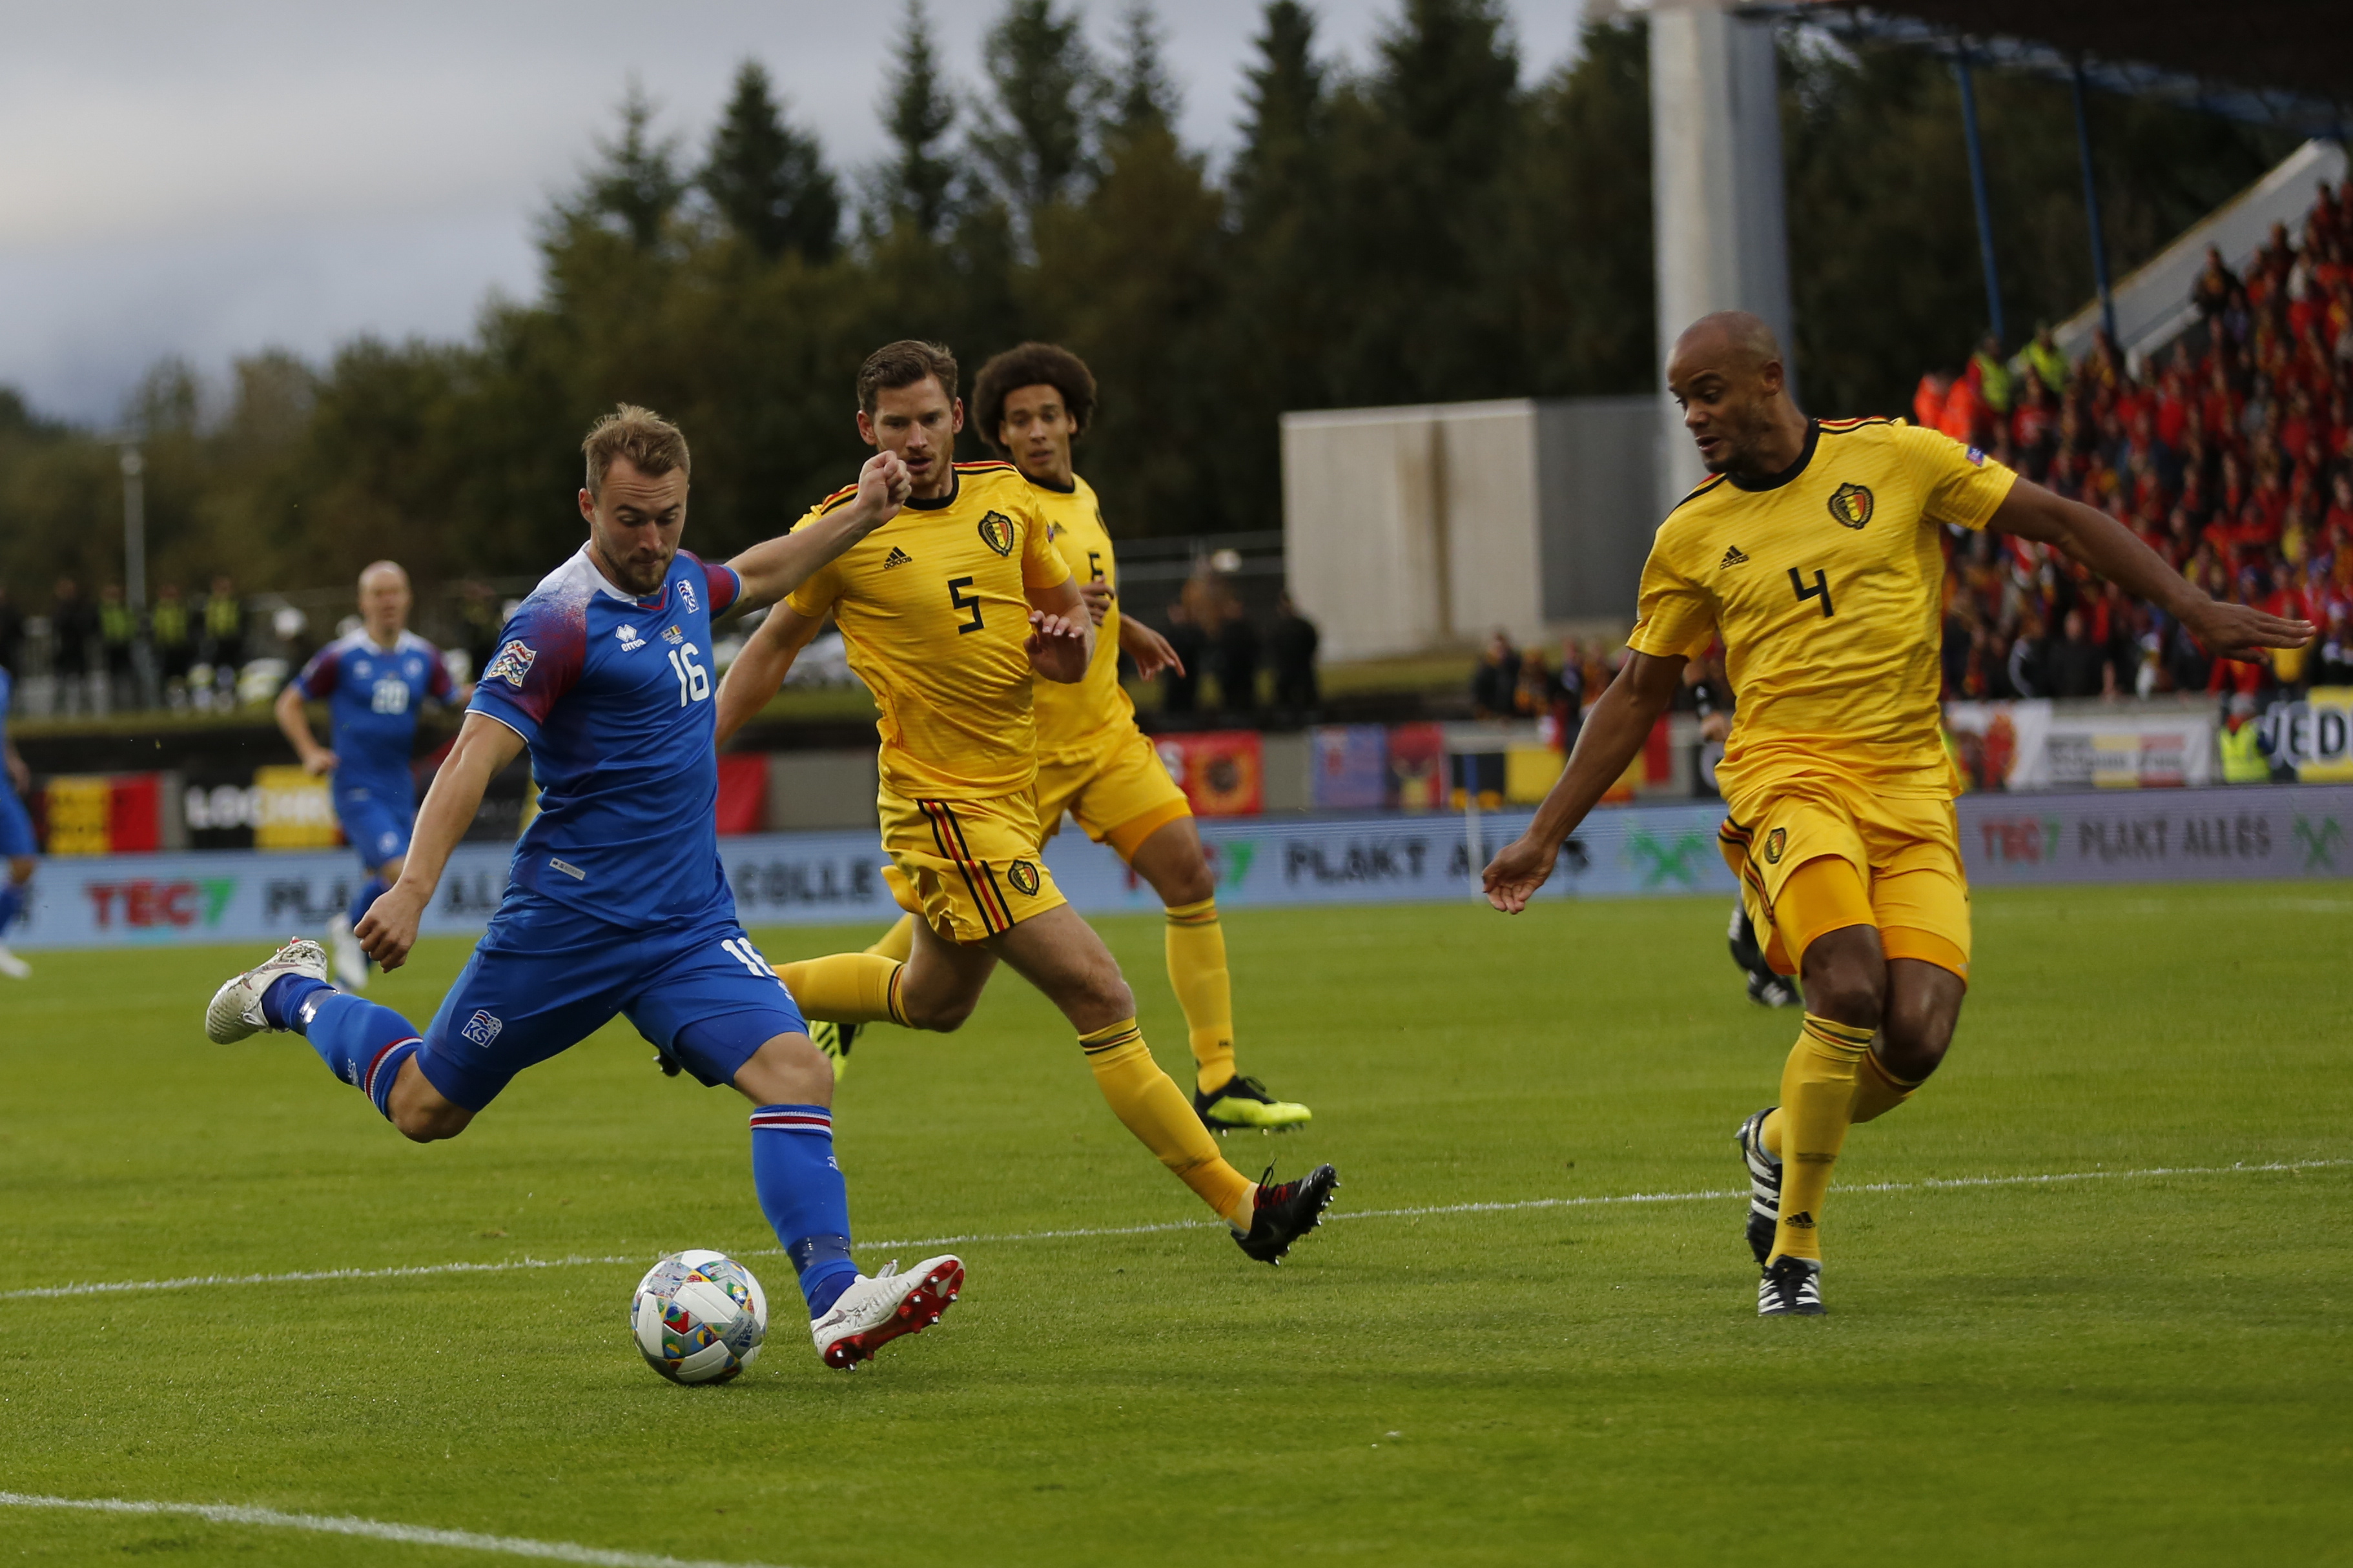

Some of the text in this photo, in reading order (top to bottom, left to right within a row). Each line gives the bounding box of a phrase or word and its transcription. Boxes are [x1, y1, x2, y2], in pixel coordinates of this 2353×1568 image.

[883, 556, 912, 569] adidas
[1720, 555, 1749, 570] adidas
[947, 576, 984, 634] 5
[1788, 567, 1834, 617] 4
[668, 642, 710, 708] 16
[1284, 839, 1428, 884] PLAKT
[85, 879, 236, 928] TEC7
